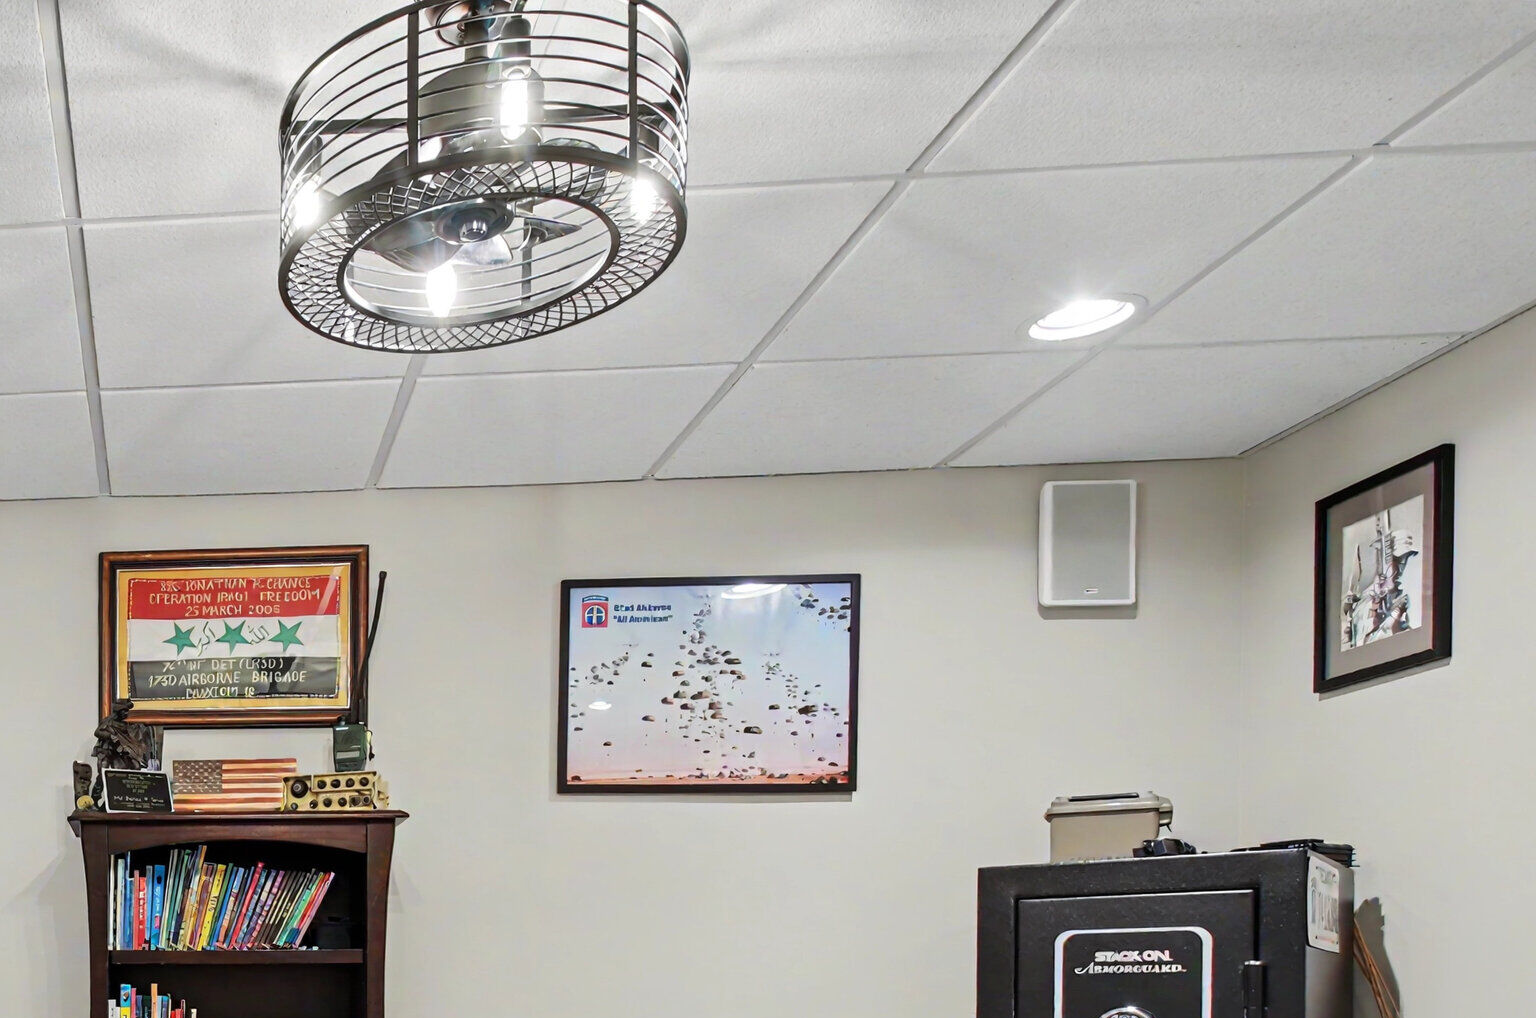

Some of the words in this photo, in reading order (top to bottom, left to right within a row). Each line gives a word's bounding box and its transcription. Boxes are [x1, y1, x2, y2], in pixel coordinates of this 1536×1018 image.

[149, 593, 211, 605] OPERATION
[202, 604, 241, 616] MARCH
[211, 659, 237, 670] DET
[178, 671, 241, 686] AIRBORNE
[251, 670, 307, 683] BRIGADE
